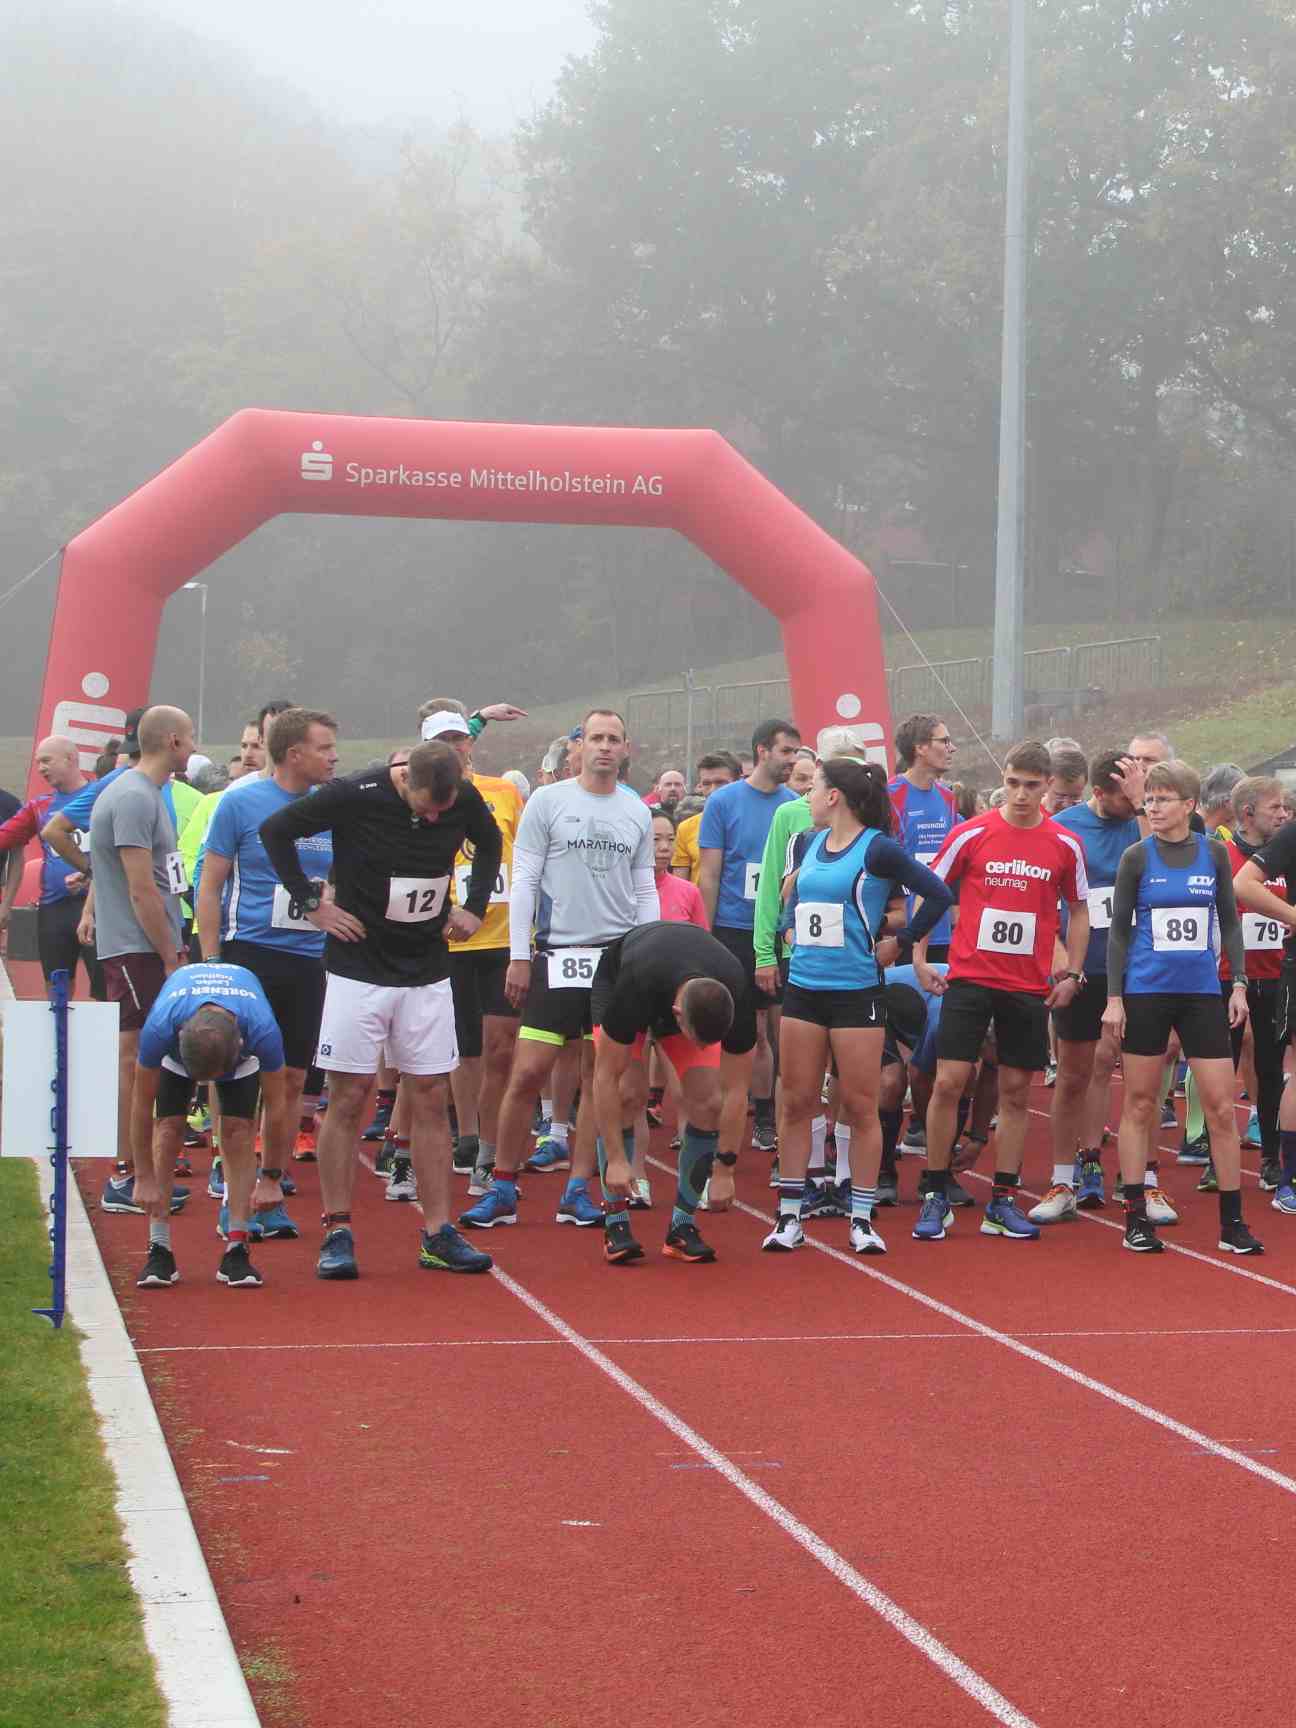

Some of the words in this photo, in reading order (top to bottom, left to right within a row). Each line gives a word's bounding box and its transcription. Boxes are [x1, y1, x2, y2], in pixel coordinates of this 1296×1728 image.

[346, 463, 462, 488] Sparkasse
[470, 468, 625, 494] Mittelholstein
[632, 475, 663, 496] AG
[567, 839, 632, 854] MARATHON
[984, 875, 1028, 891] neumag
[406, 889, 437, 913] 12
[809, 914, 822, 937] 8
[992, 921, 1024, 945] 80
[1166, 918, 1198, 941] 89
[1254, 922, 1279, 941] 79
[562, 958, 593, 979] 85
